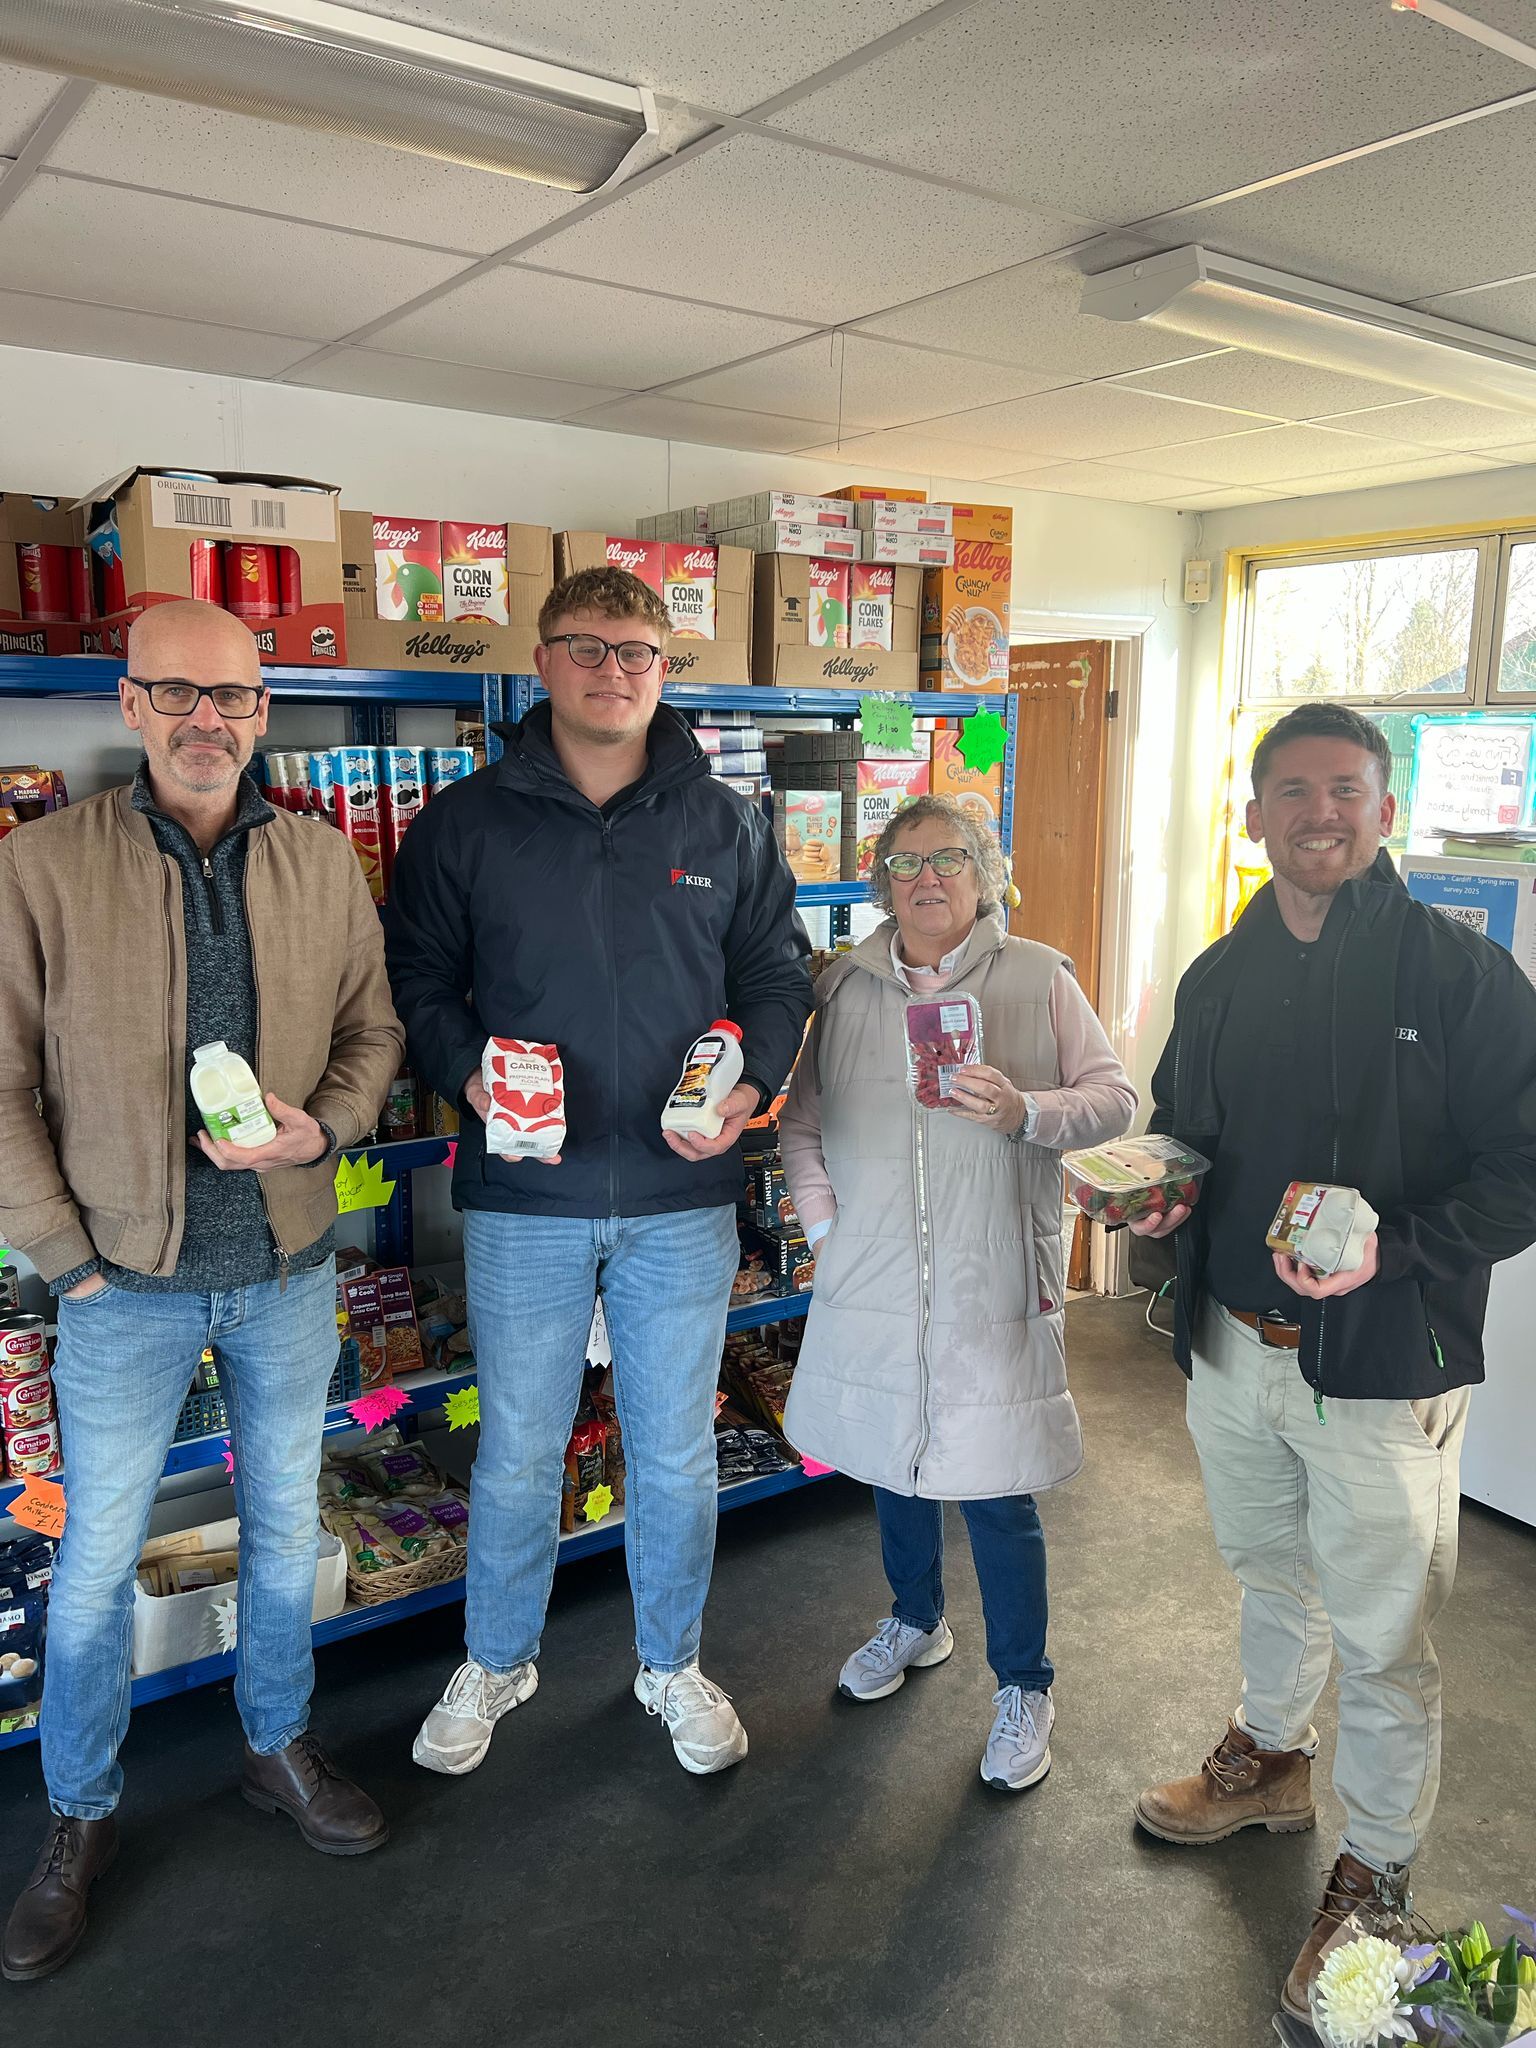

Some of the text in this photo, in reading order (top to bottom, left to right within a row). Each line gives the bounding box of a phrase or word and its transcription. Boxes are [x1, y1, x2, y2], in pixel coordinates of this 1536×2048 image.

[157, 480, 197, 492] ORIGINAL
[466, 528, 507, 556] Kello
[684, 550, 717, 576] Kello
[453, 568, 492, 586] CORN
[955, 575, 991, 593] CRUNCHY
[454, 585, 492, 598] FLAKES
[672, 587, 703, 603] CORN
[966, 589, 983, 598] NUT
[672, 602, 703, 614] FLAKES
[858, 602, 884, 617] CORN
[858, 617, 884, 629] FLAKES
[0, 633, 45, 655] RINGLES
[311, 645, 337, 656] PRINGLES
[405, 631, 486, 664] Kellogg's
[990, 654, 1008, 665] WIN
[822, 655, 875, 683] Kellogg's
[873, 763, 918, 785] Kellogg's
[958, 776, 973, 784] NUT
[863, 797, 890, 811] CORN
[391, 807, 420, 823] PRINGL
[863, 811, 890, 820] FLAKES
[685, 875, 713, 889] KIER
[1413, 872, 1431, 880] FOOD
[1451, 875, 1473, 883] Cardiff
[1477, 878, 1498, 887] Spring
[1443, 887, 1480, 895] survey 2025
[510, 1062, 548, 1072] CARR'S
[764, 1169, 773, 1207] AINSLEY
[780, 1239, 788, 1276] AINSLEY
[358, 1283, 377, 1292] Simply
[7, 1337, 42, 1352] Carnation
[17, 1385, 49, 1400] Carnation
[15, 1438, 50, 1451] Carnation
